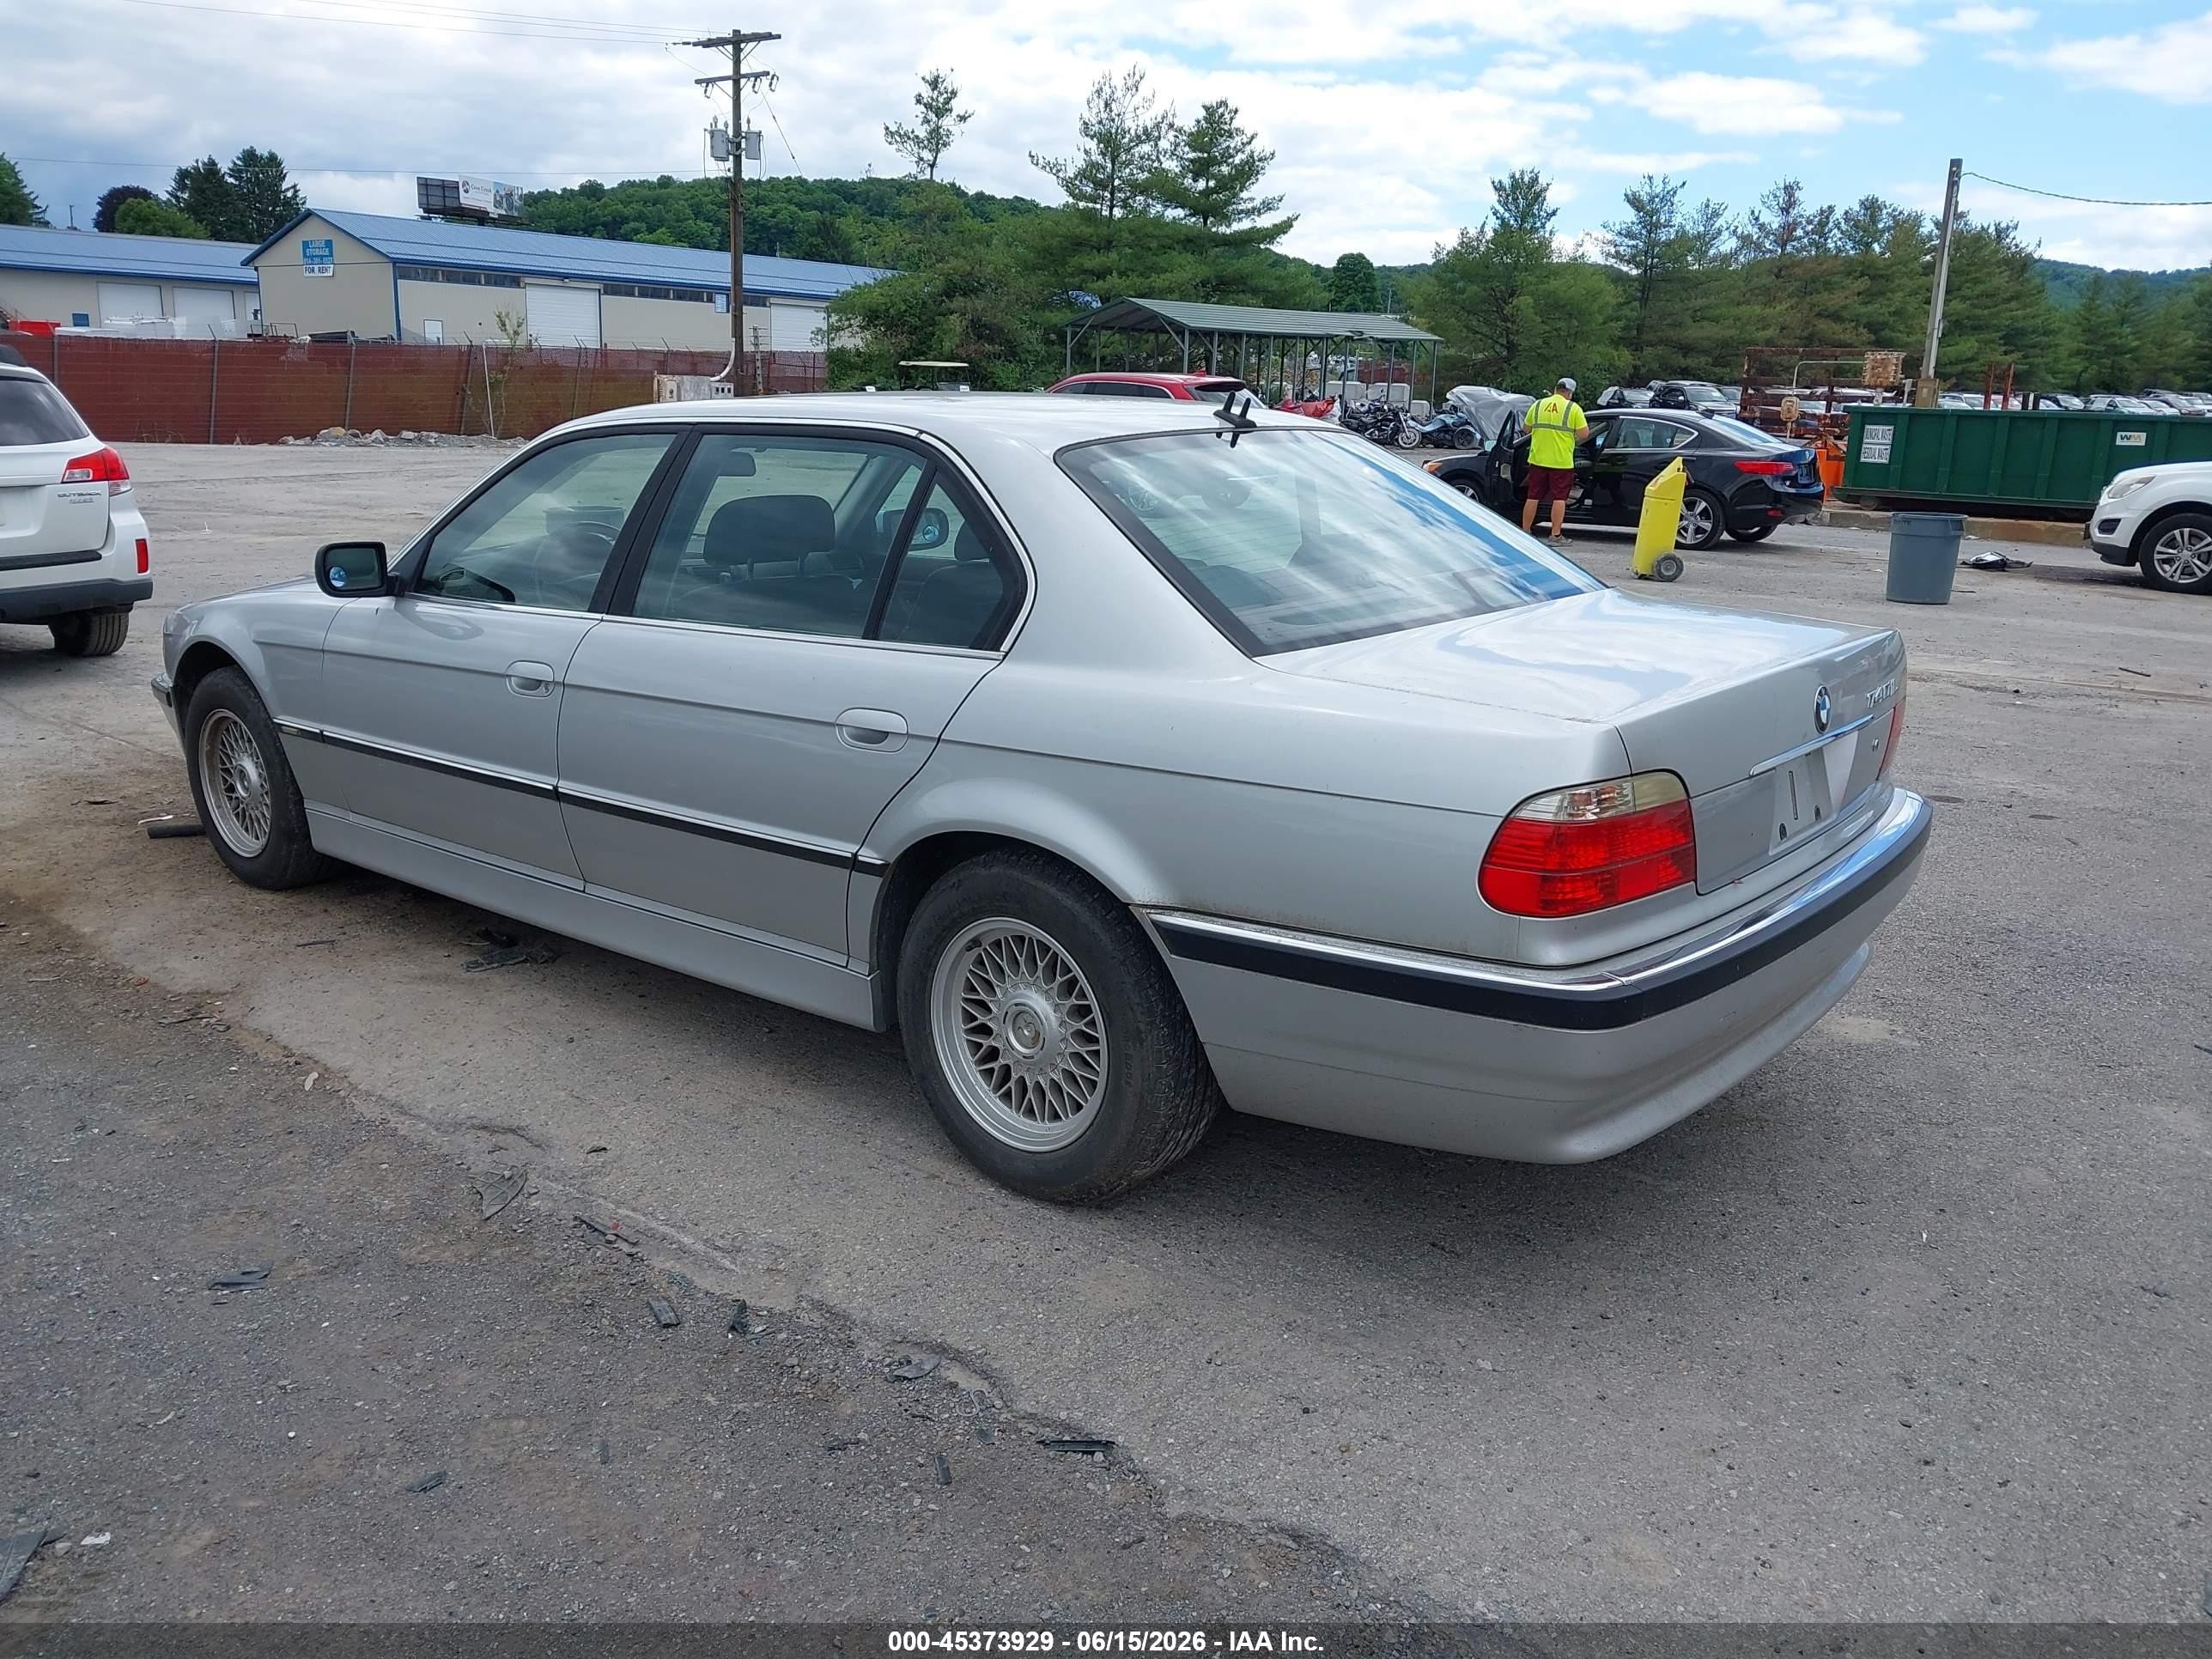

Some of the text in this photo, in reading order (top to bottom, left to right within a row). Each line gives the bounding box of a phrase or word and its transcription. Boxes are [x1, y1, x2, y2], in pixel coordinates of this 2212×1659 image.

[309, 240, 325, 248] LARGE
[1881, 428, 1893, 441] WASTE
[1877, 447, 1889, 460] WASTE
